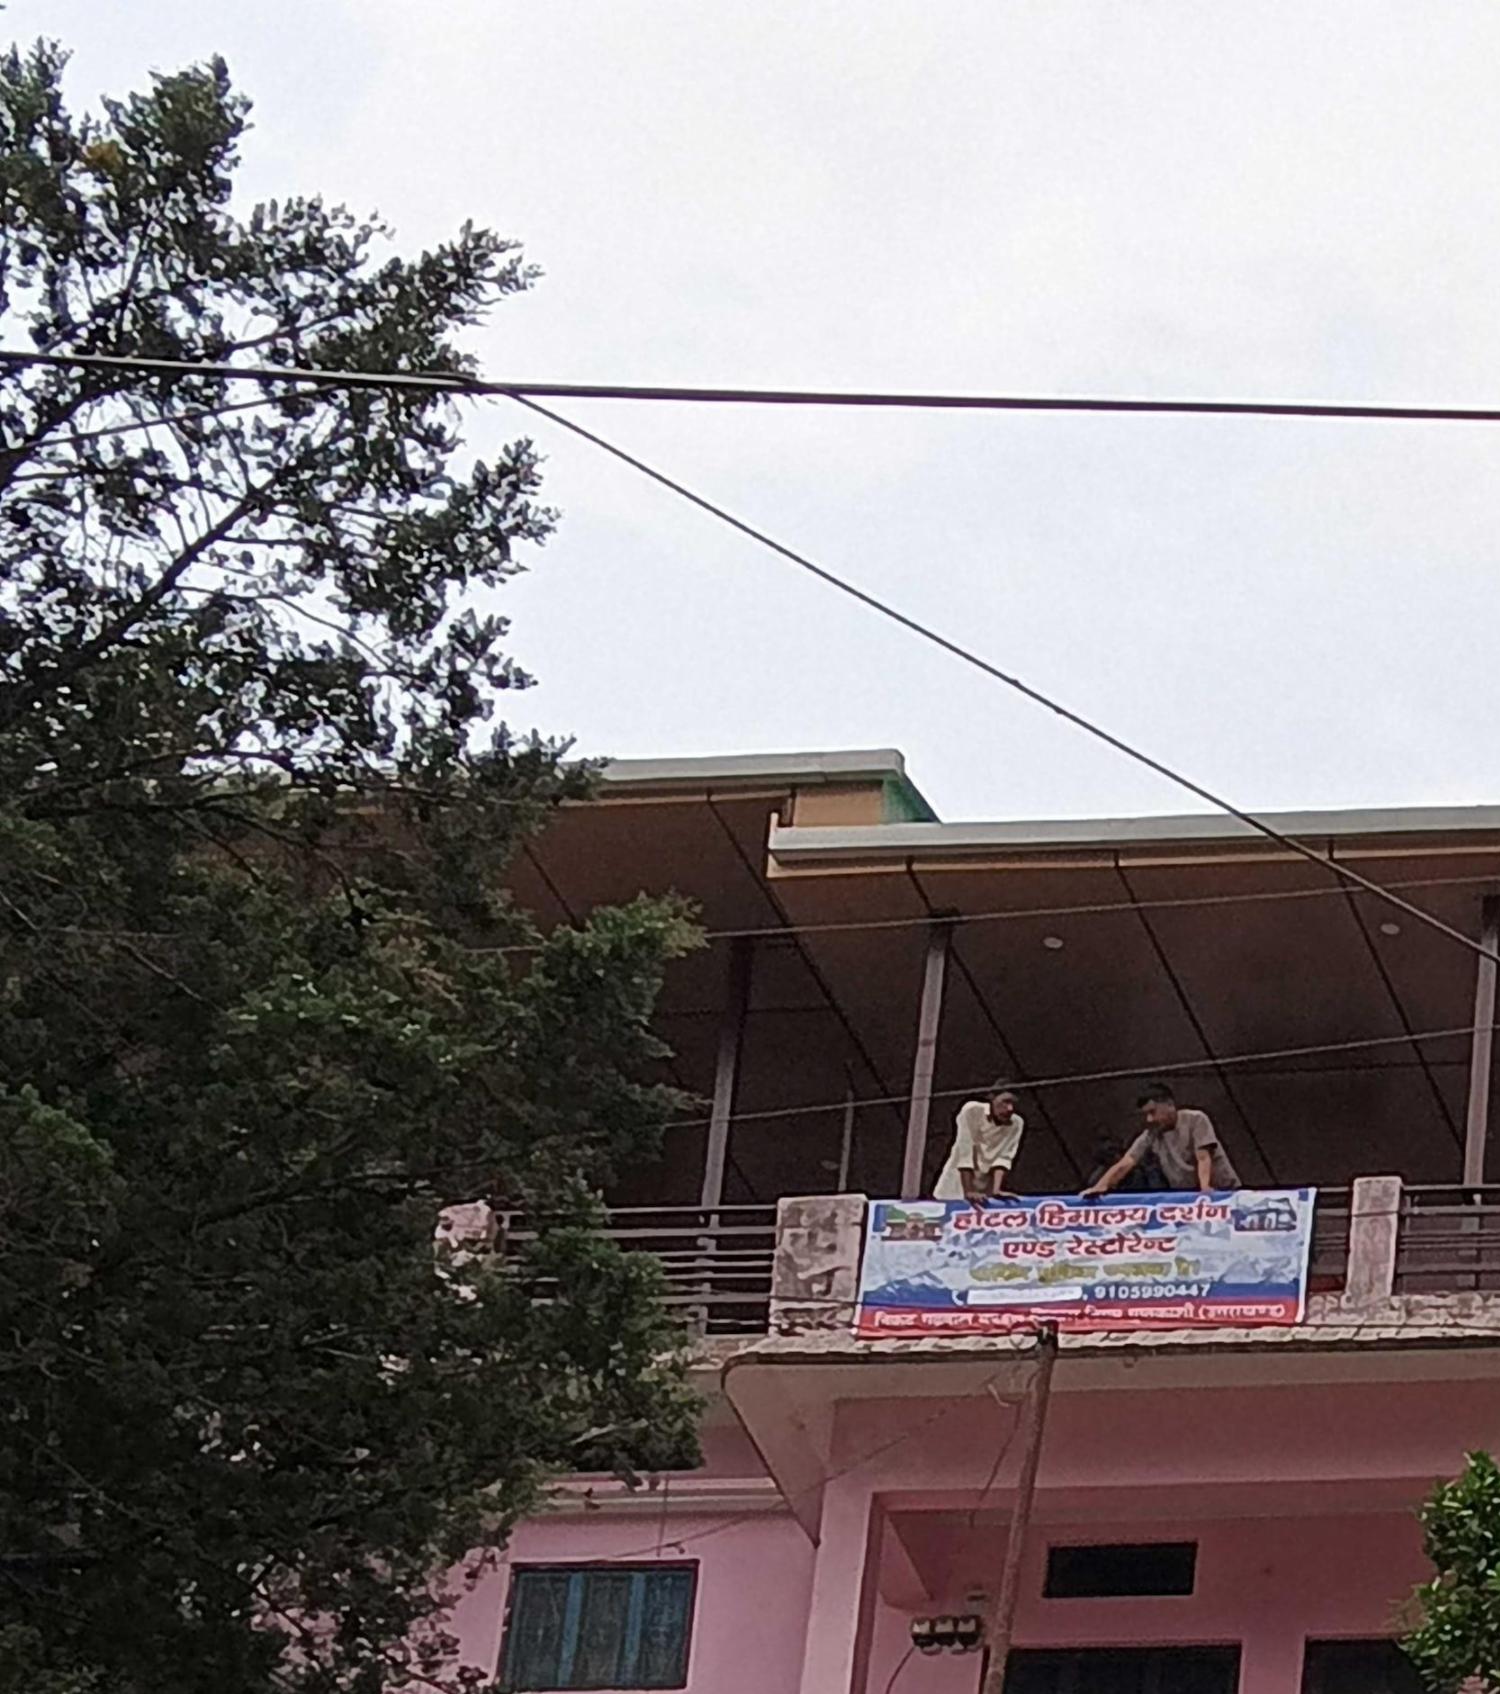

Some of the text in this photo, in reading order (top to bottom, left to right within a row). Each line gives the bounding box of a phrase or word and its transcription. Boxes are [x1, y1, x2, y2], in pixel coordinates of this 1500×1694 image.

[954, 1200, 1229, 1230] होटल हिमालय दर्शन
[1003, 1240, 1056, 1258] एण्ड
